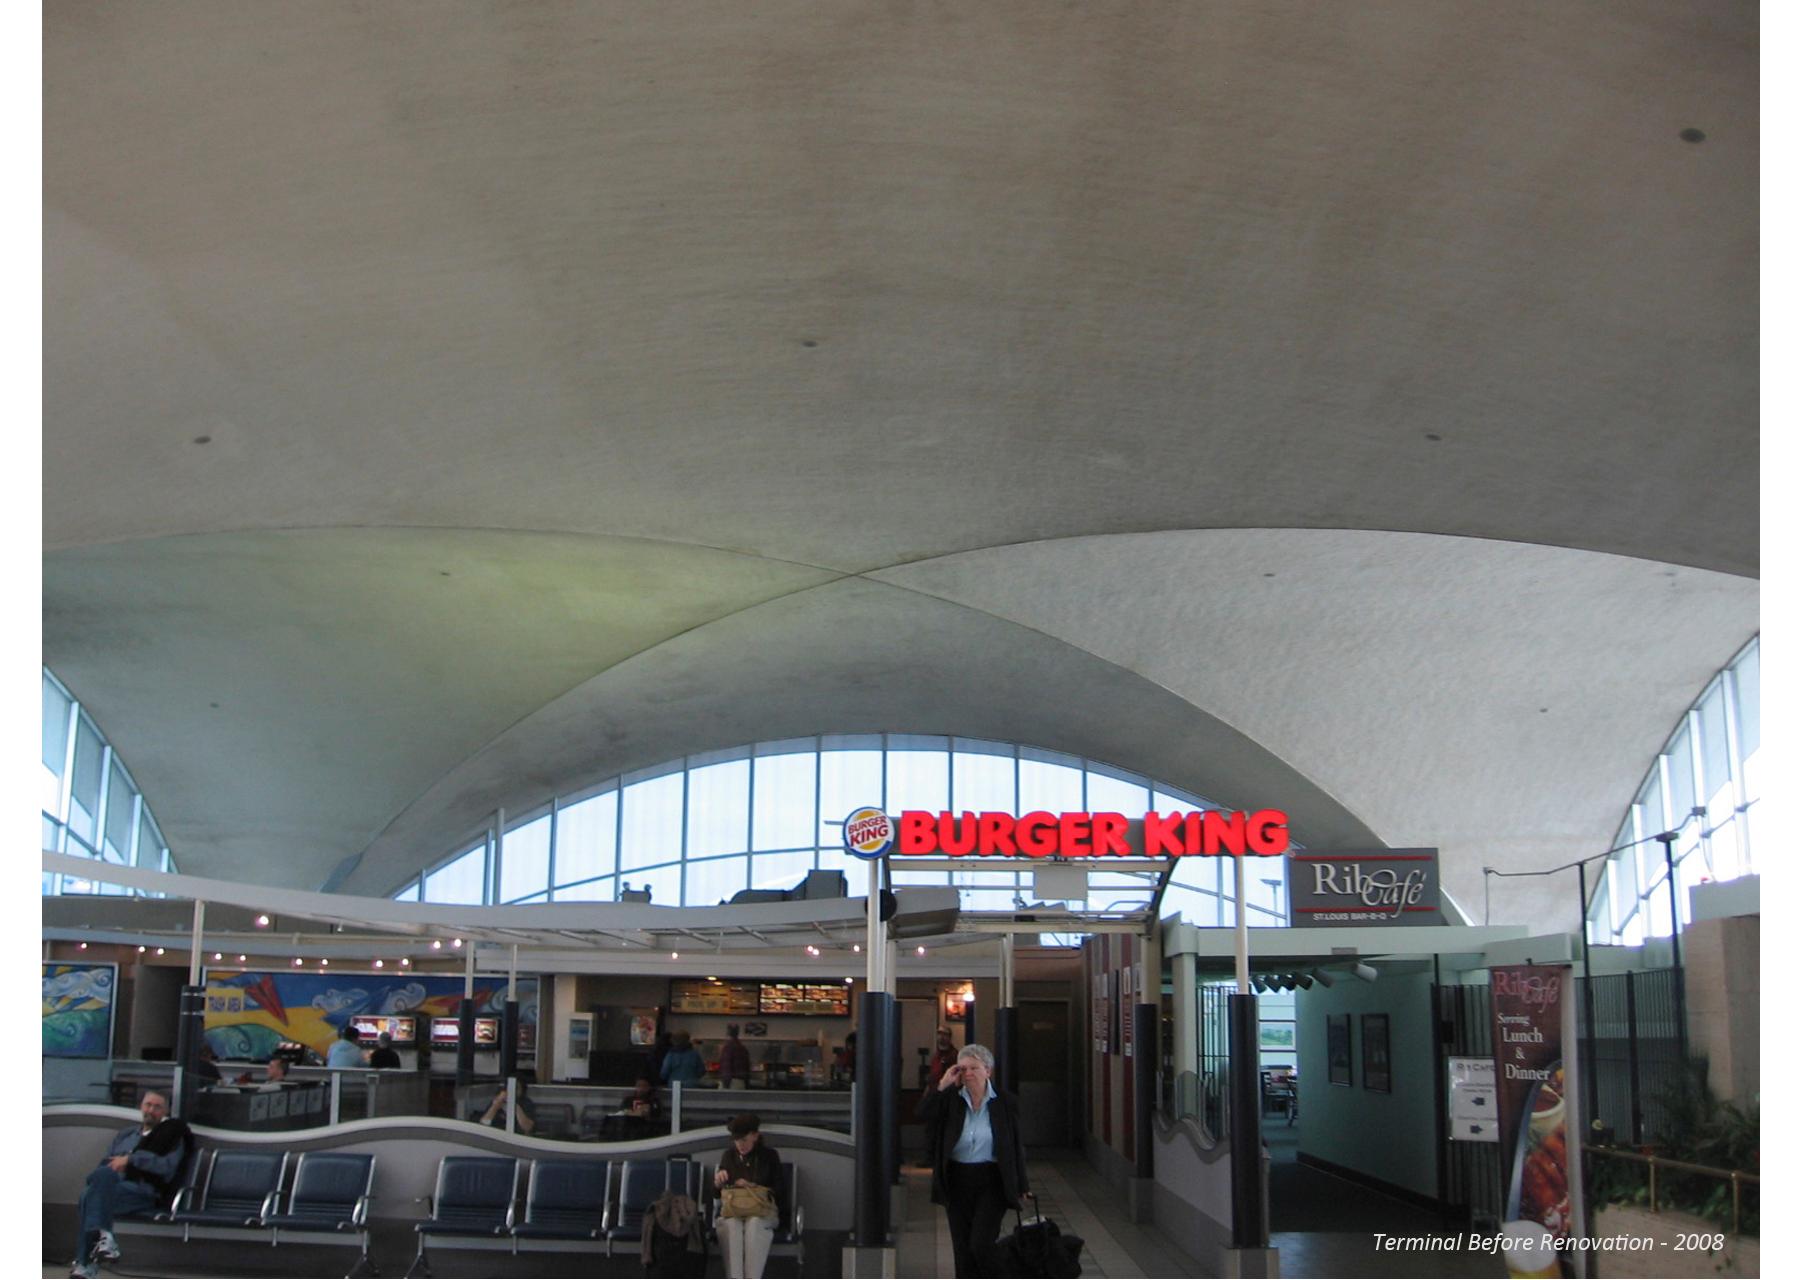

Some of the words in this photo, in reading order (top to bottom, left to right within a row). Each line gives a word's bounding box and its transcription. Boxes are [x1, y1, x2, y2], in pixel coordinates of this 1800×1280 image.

[848, 815, 887, 834] BURGER
[901, 810, 1131, 857] BURGER
[1144, 808, 1290, 857] KING
[850, 824, 889, 847] KING
[1311, 863, 1374, 895] Rib
[1361, 869, 1427, 918] Café
[1503, 1027, 1543, 1043] Lunch
[1515, 1047, 1525, 1059] &
[1505, 1063, 1551, 1080] Dinner
